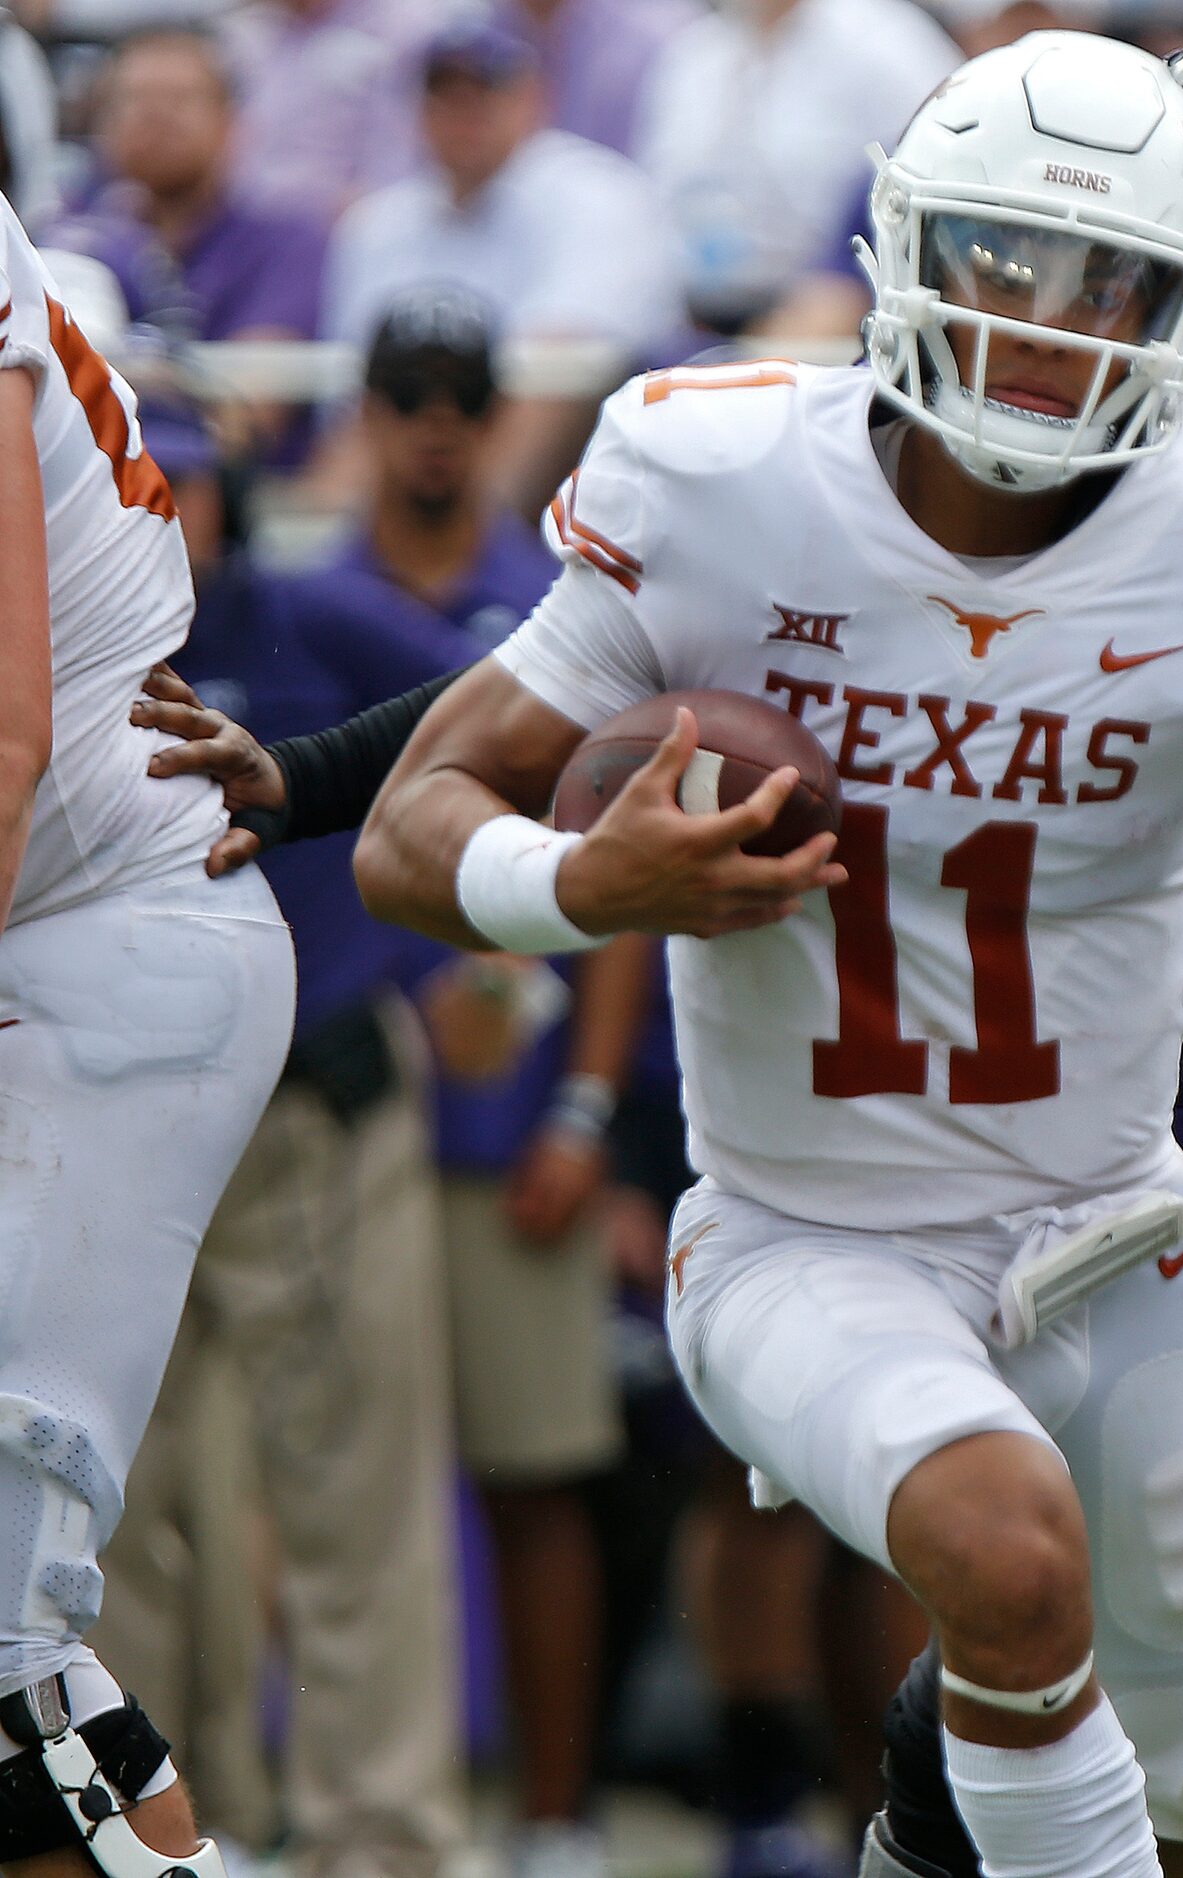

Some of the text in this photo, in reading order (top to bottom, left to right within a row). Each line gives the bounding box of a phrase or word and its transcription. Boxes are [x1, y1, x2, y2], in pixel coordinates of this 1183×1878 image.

[1043, 163, 1111, 193] HORNS
[767, 602, 851, 654] XII
[765, 668, 1151, 804] TEXAS
[812, 800, 1062, 1104] 11
